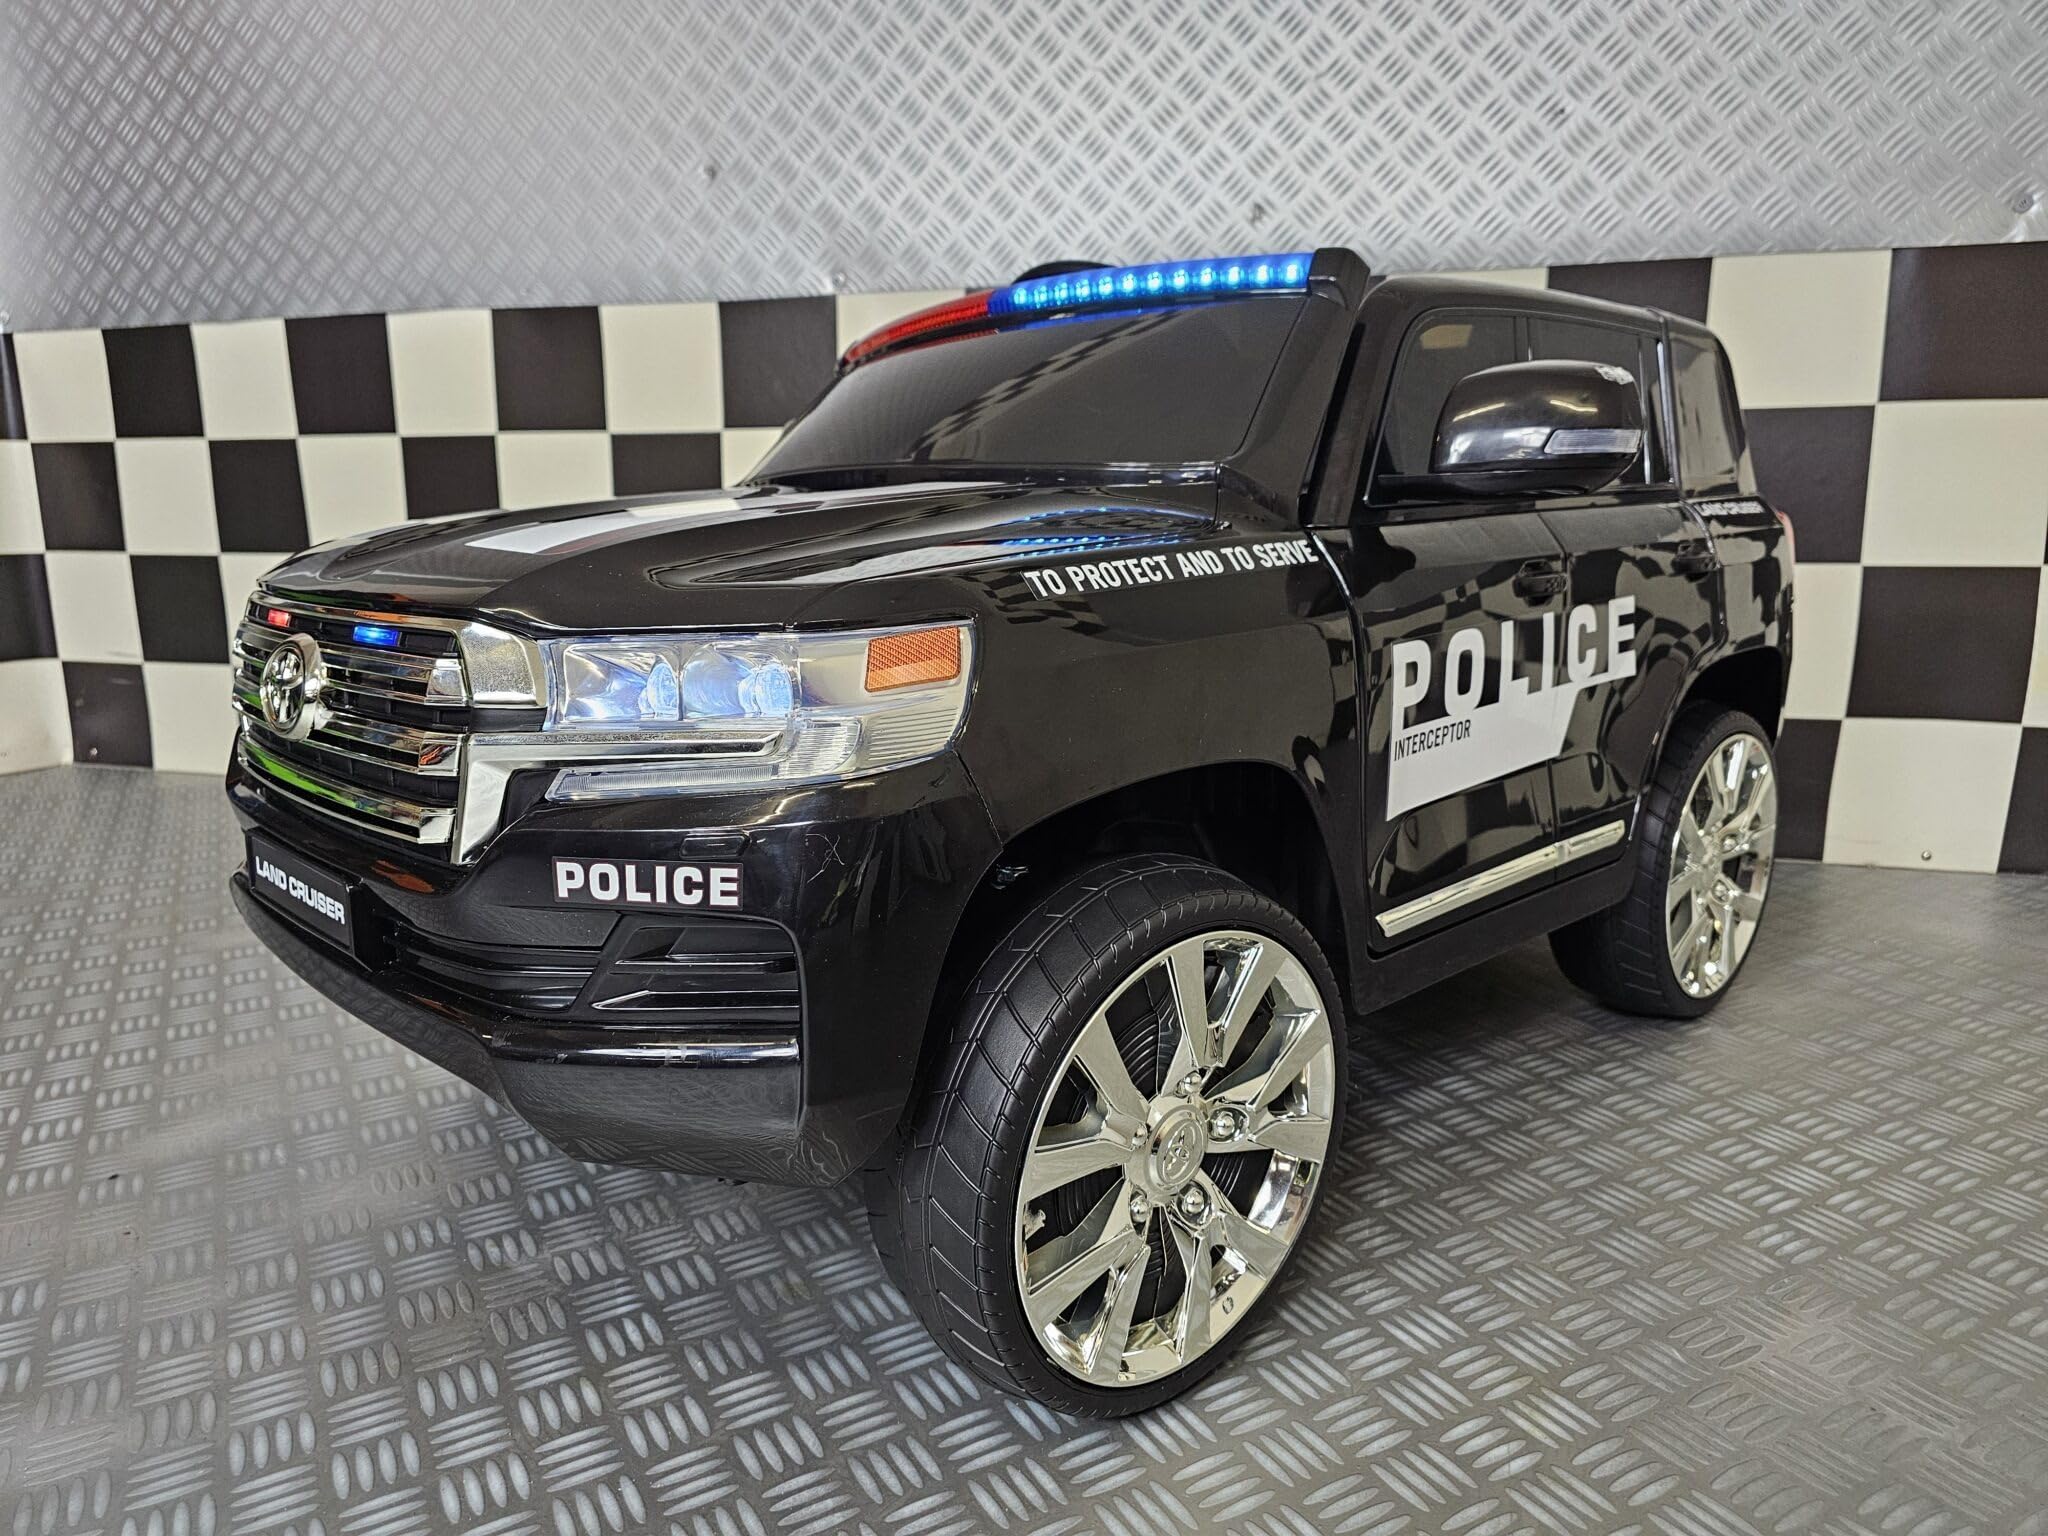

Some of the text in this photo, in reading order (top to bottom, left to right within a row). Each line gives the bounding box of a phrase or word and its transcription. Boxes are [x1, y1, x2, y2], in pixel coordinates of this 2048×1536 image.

[1025, 539, 1319, 597] TO PROTECT AND TO SERVE
[1392, 595, 1636, 729] POLICE
[1394, 719, 1471, 762] INTERCEPTOR
[255, 855, 346, 925] LAND CRUISER
[556, 861, 739, 906] POLICE
